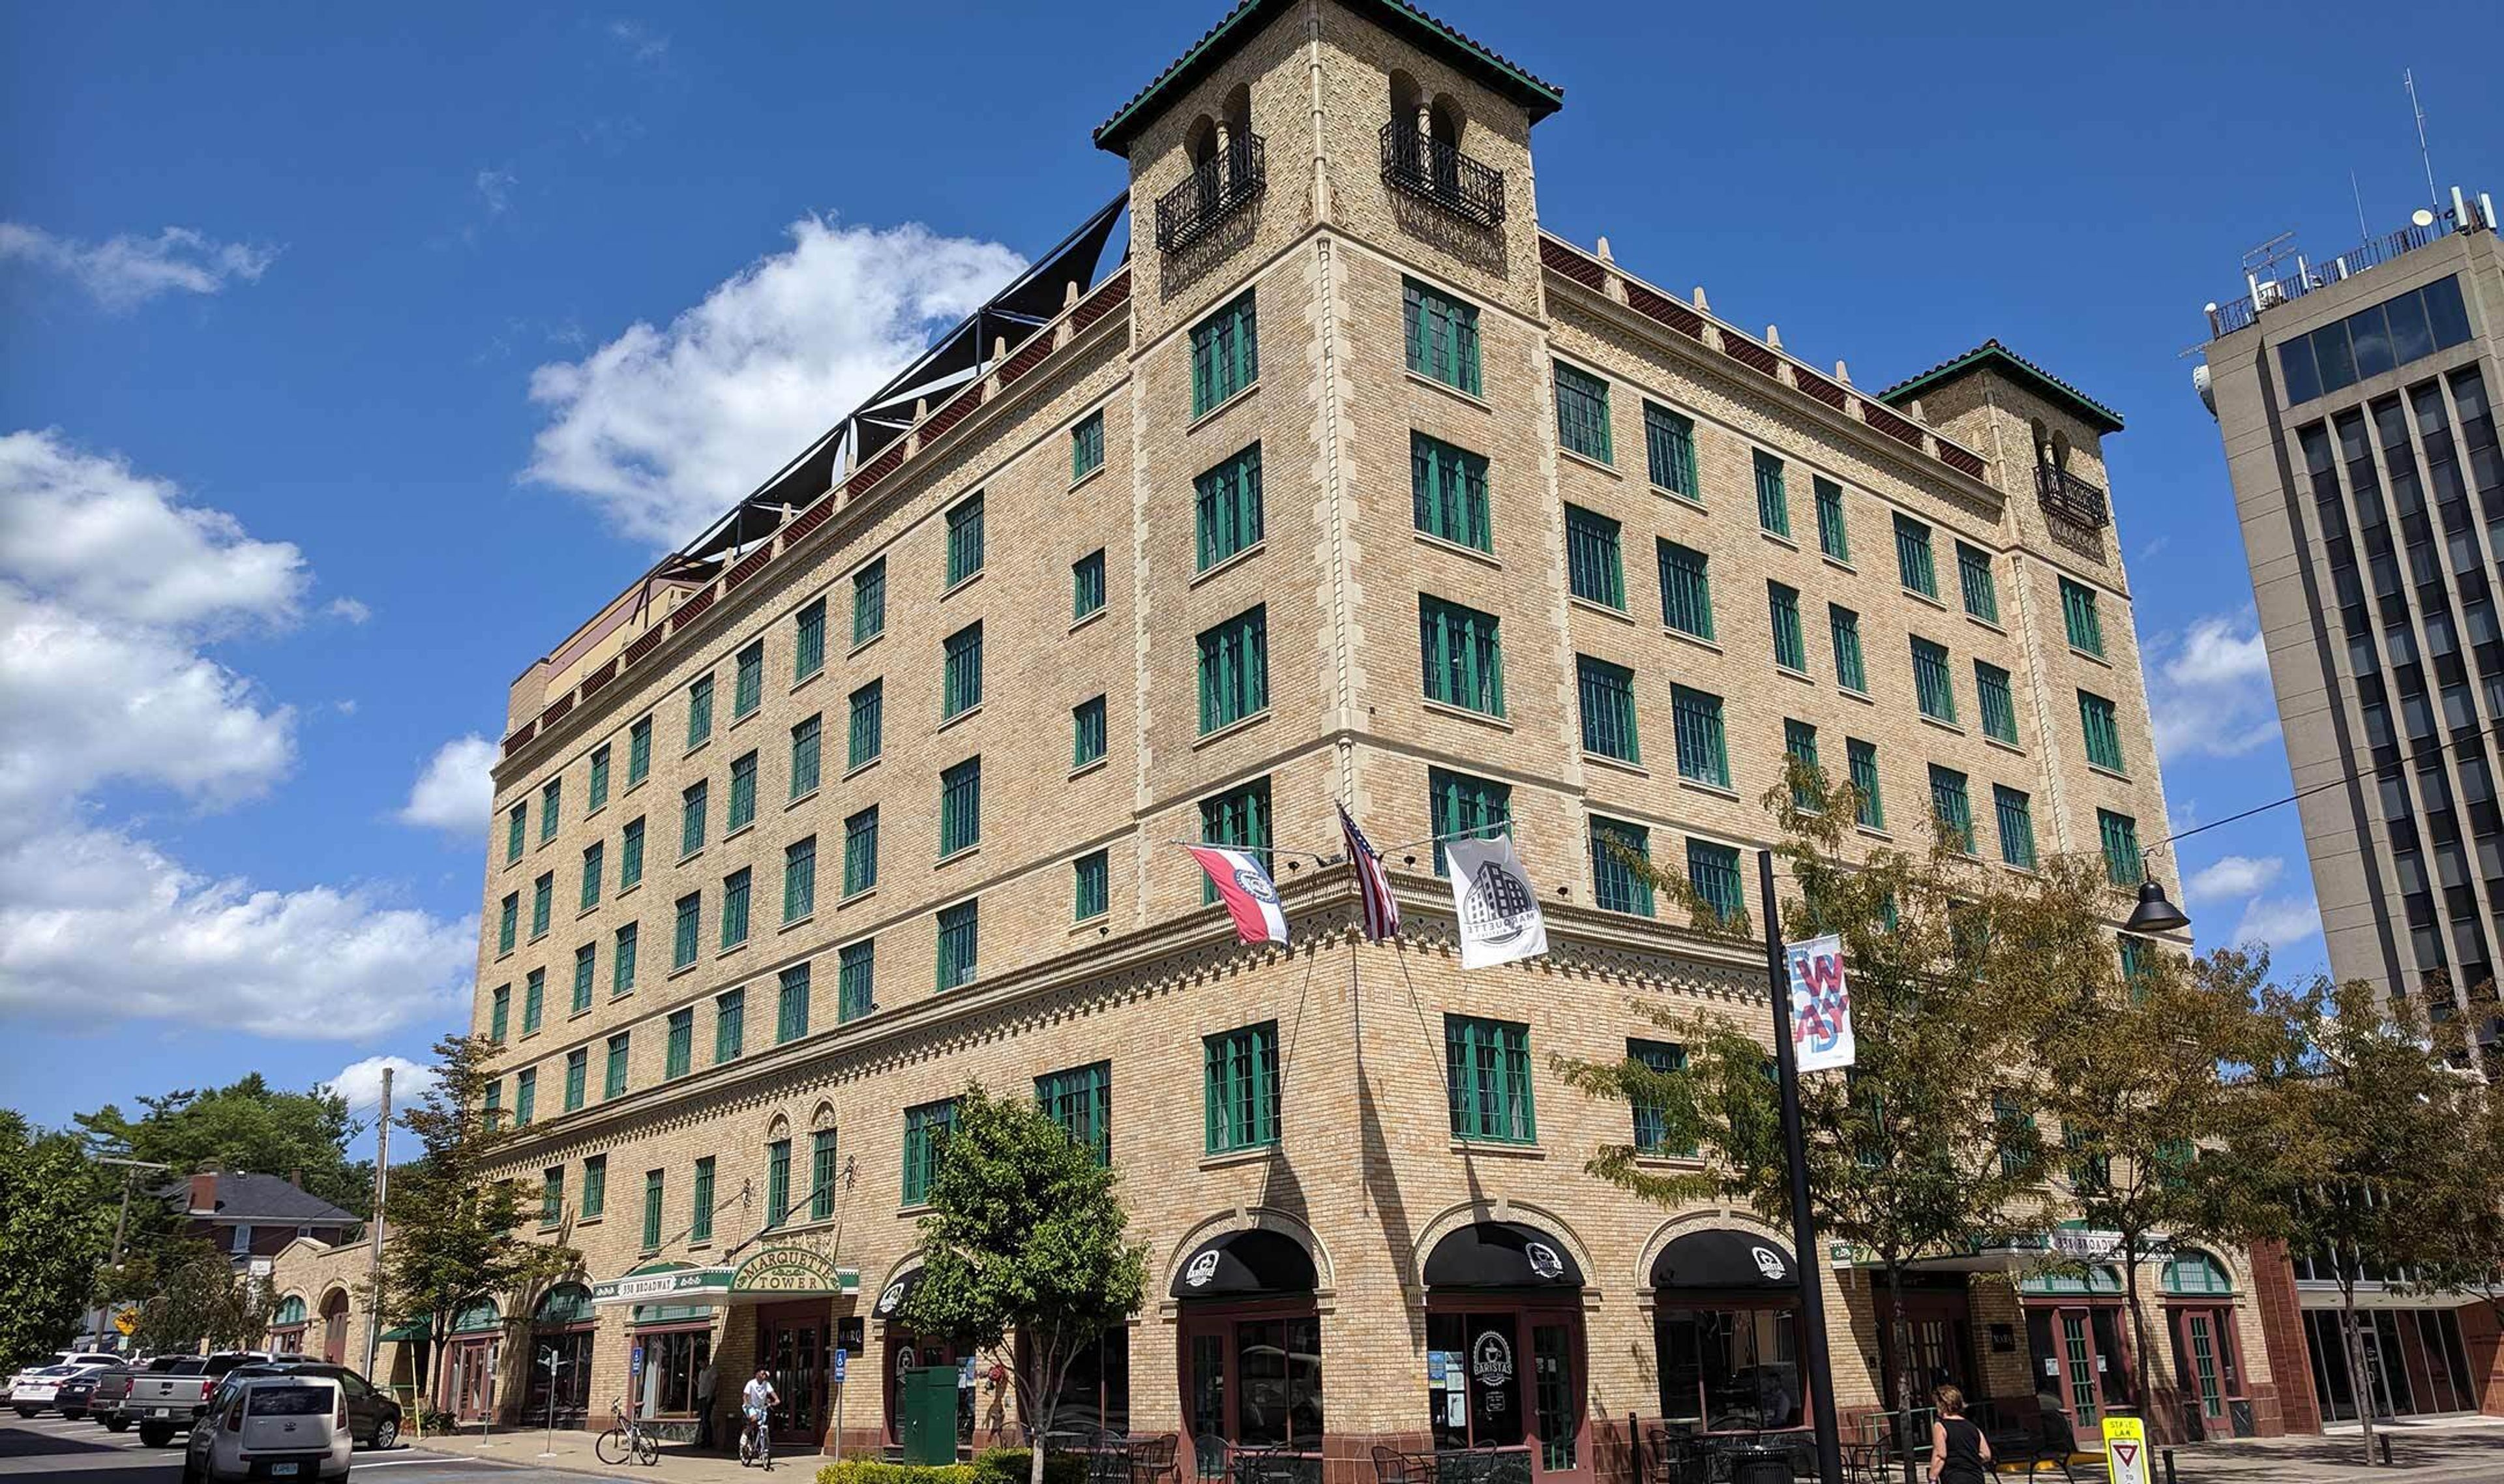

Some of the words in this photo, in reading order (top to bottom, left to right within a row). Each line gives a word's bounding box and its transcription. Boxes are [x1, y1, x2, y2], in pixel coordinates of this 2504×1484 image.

[744, 1252, 833, 1280] MARQUETTE
[636, 1279, 670, 1292] BROADWAY
[760, 1277, 816, 1289] TOWER
[1474, 1362, 1513, 1375] BARISTAS
